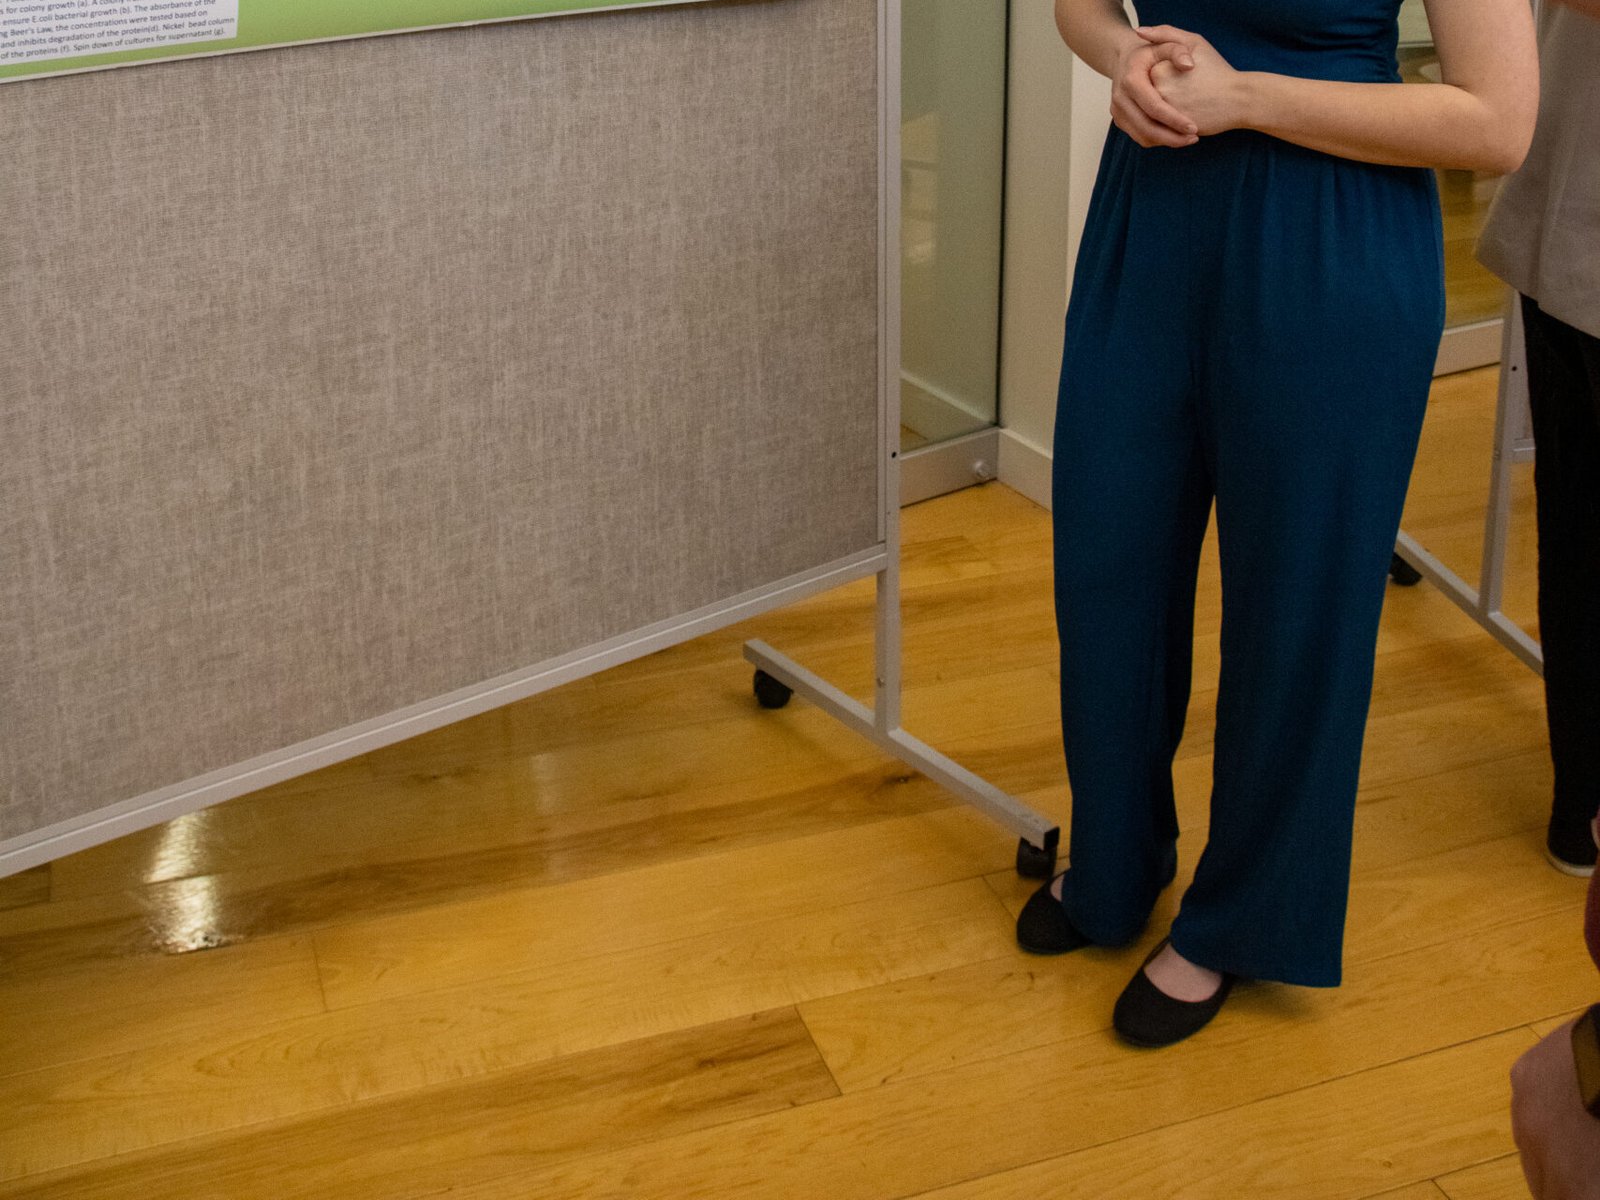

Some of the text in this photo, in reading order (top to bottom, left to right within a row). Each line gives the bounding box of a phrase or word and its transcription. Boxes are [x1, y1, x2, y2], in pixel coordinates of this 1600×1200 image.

[6, 5, 18, 13] for
[19, 3, 46, 12] colony
[47, 0, 76, 11] growth
